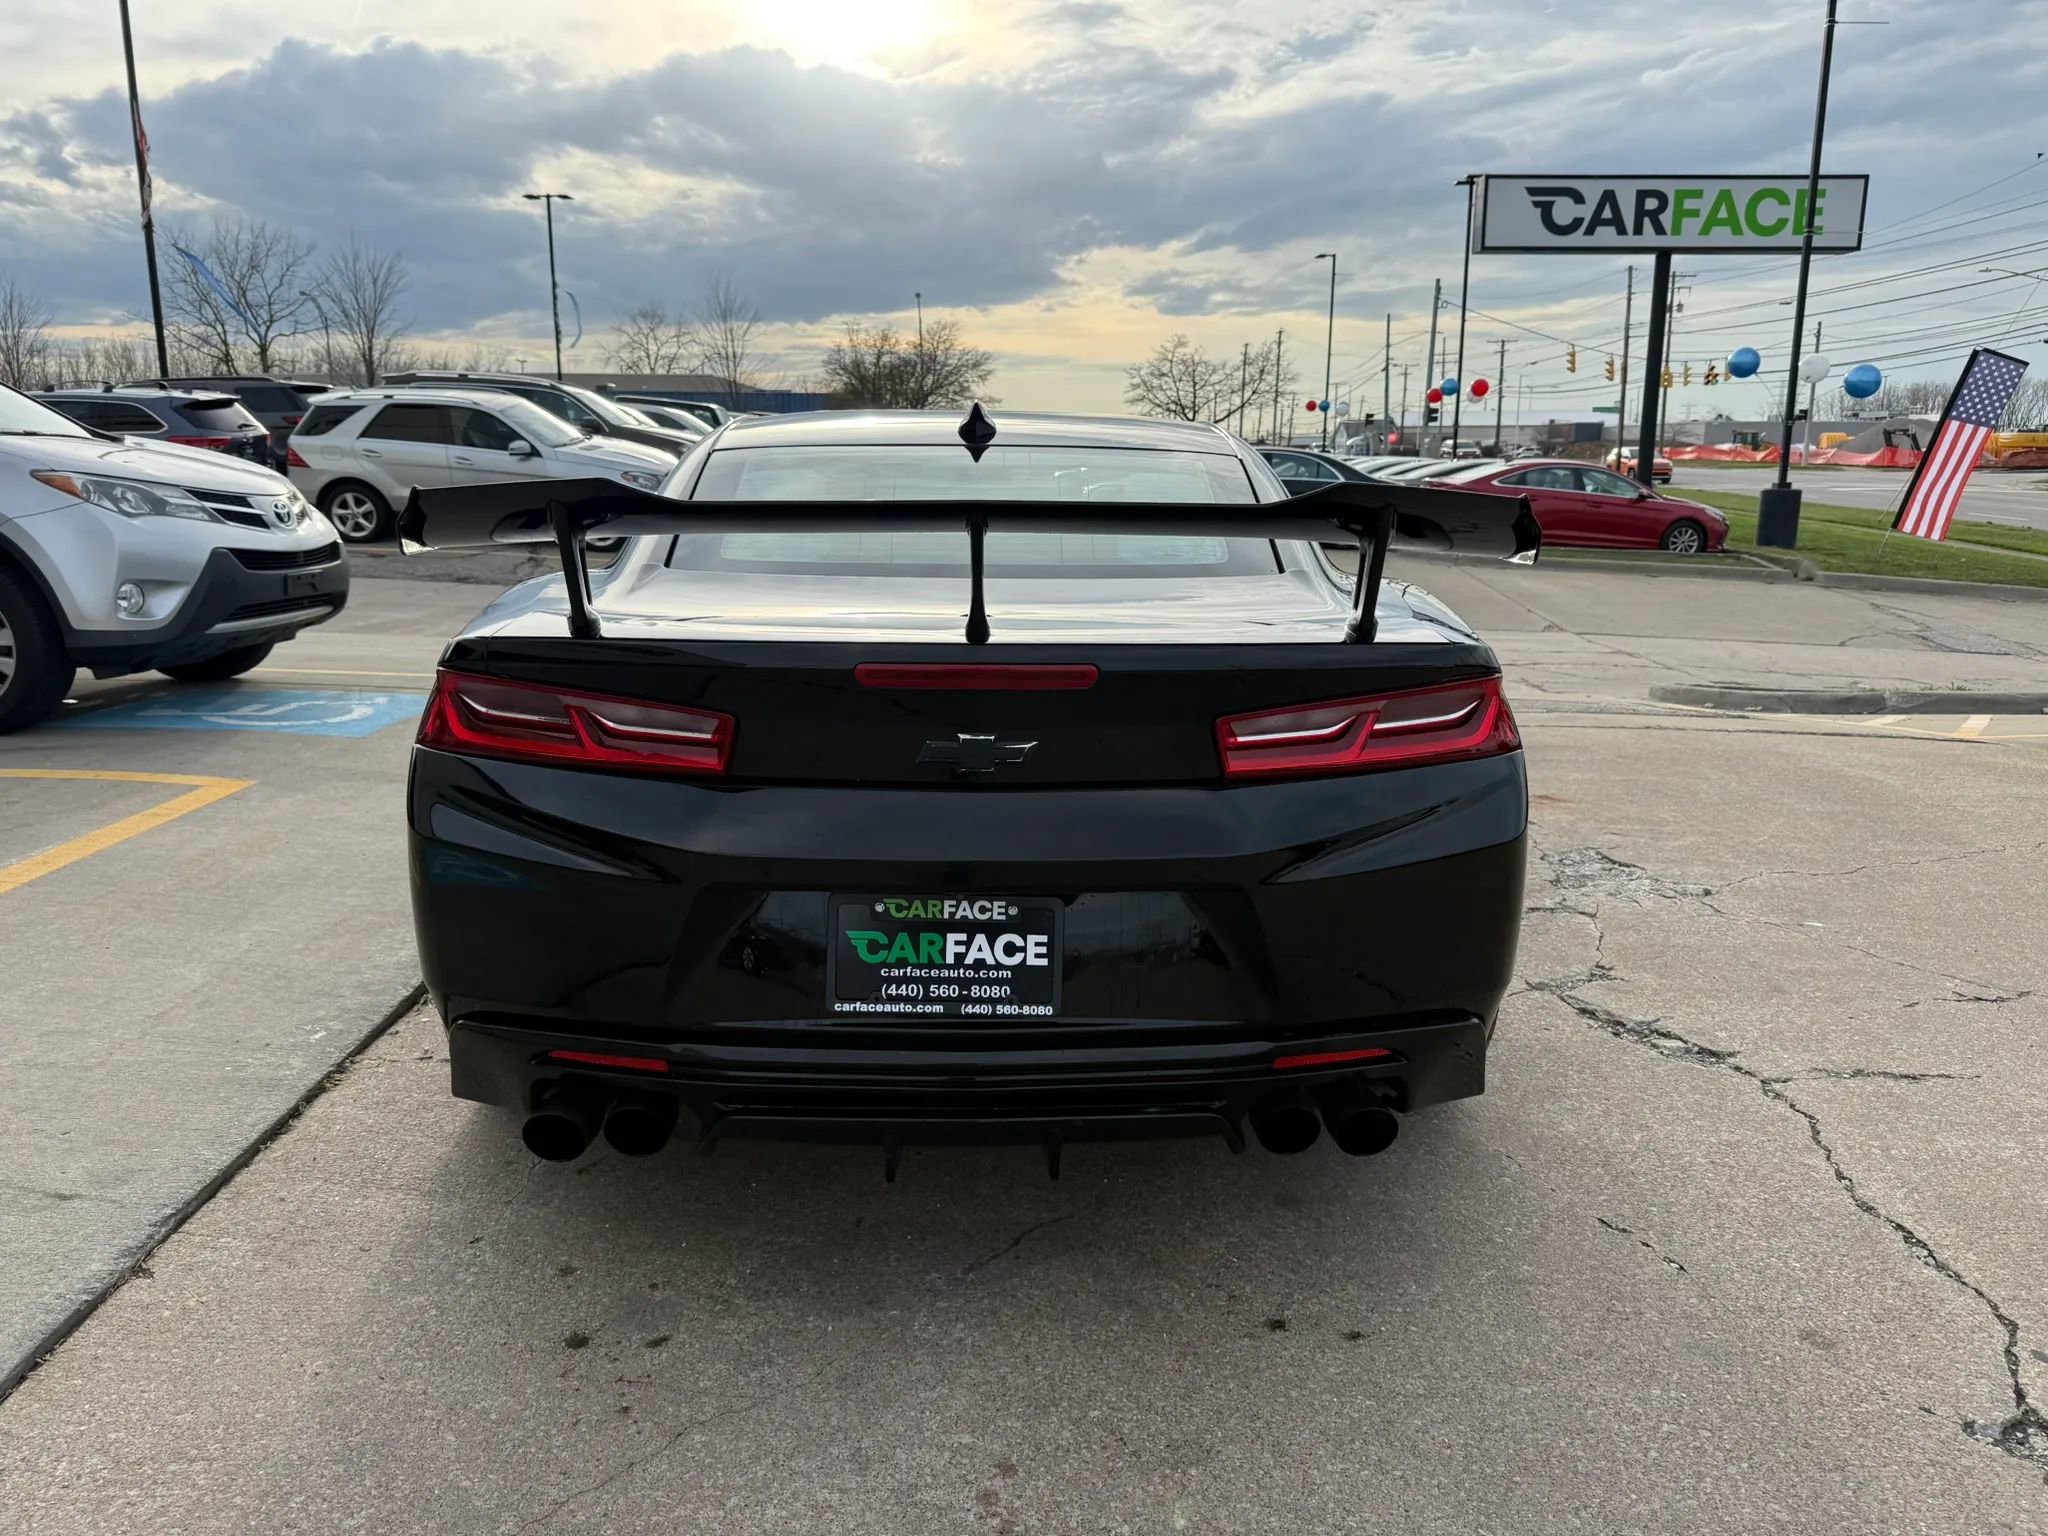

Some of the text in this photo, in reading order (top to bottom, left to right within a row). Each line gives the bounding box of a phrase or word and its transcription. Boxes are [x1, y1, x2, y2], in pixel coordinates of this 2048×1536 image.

[1524, 186, 1827, 237] CARFACE
[883, 898, 1007, 920] CARFACE
[845, 930, 1049, 966] CARFACE
[880, 966, 1012, 979] carfaceauto.com
[881, 983, 924, 999] (440)
[834, 1001, 1053, 1016] carfaceauto.com (440) 560-8080
